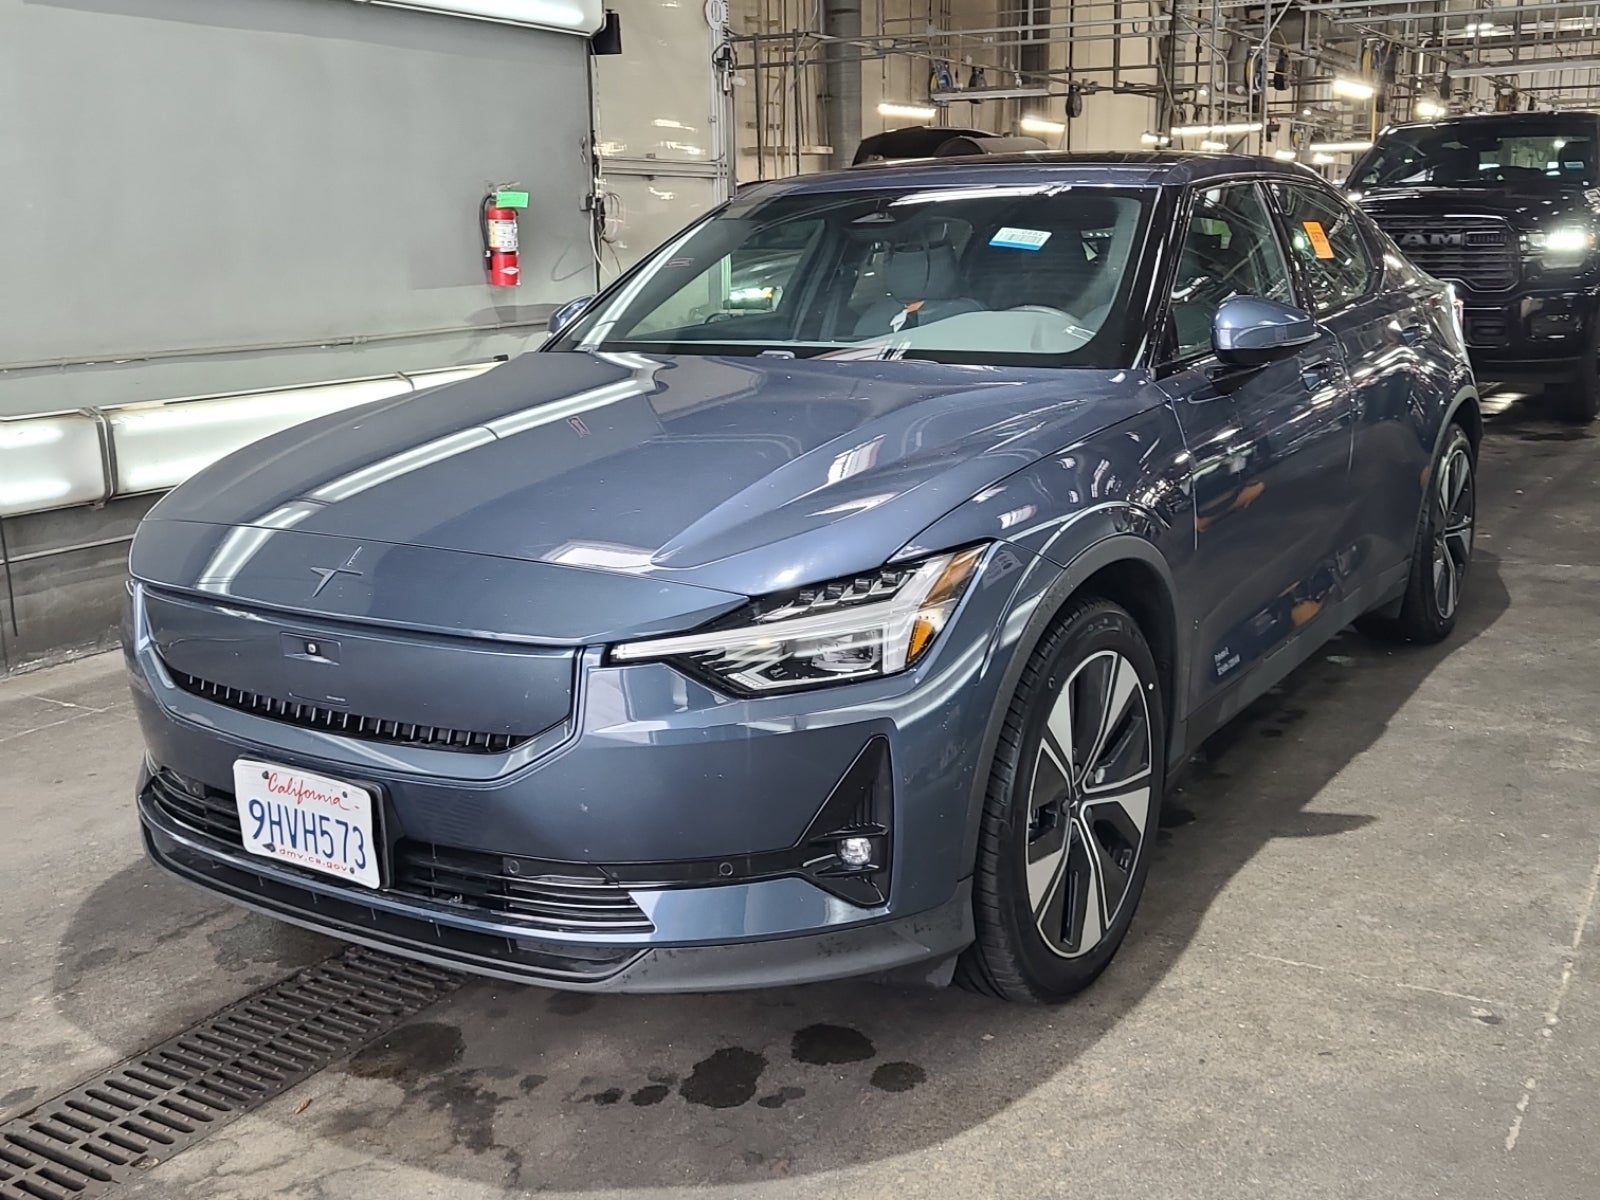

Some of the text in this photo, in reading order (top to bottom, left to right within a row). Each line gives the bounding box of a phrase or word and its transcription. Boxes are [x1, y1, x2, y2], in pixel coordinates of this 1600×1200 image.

[1391, 233, 1462, 246] AM
[268, 772, 350, 811] California
[248, 798, 366, 870] 9HVH573
[279, 848, 348, 872] dmv.ca.gov
